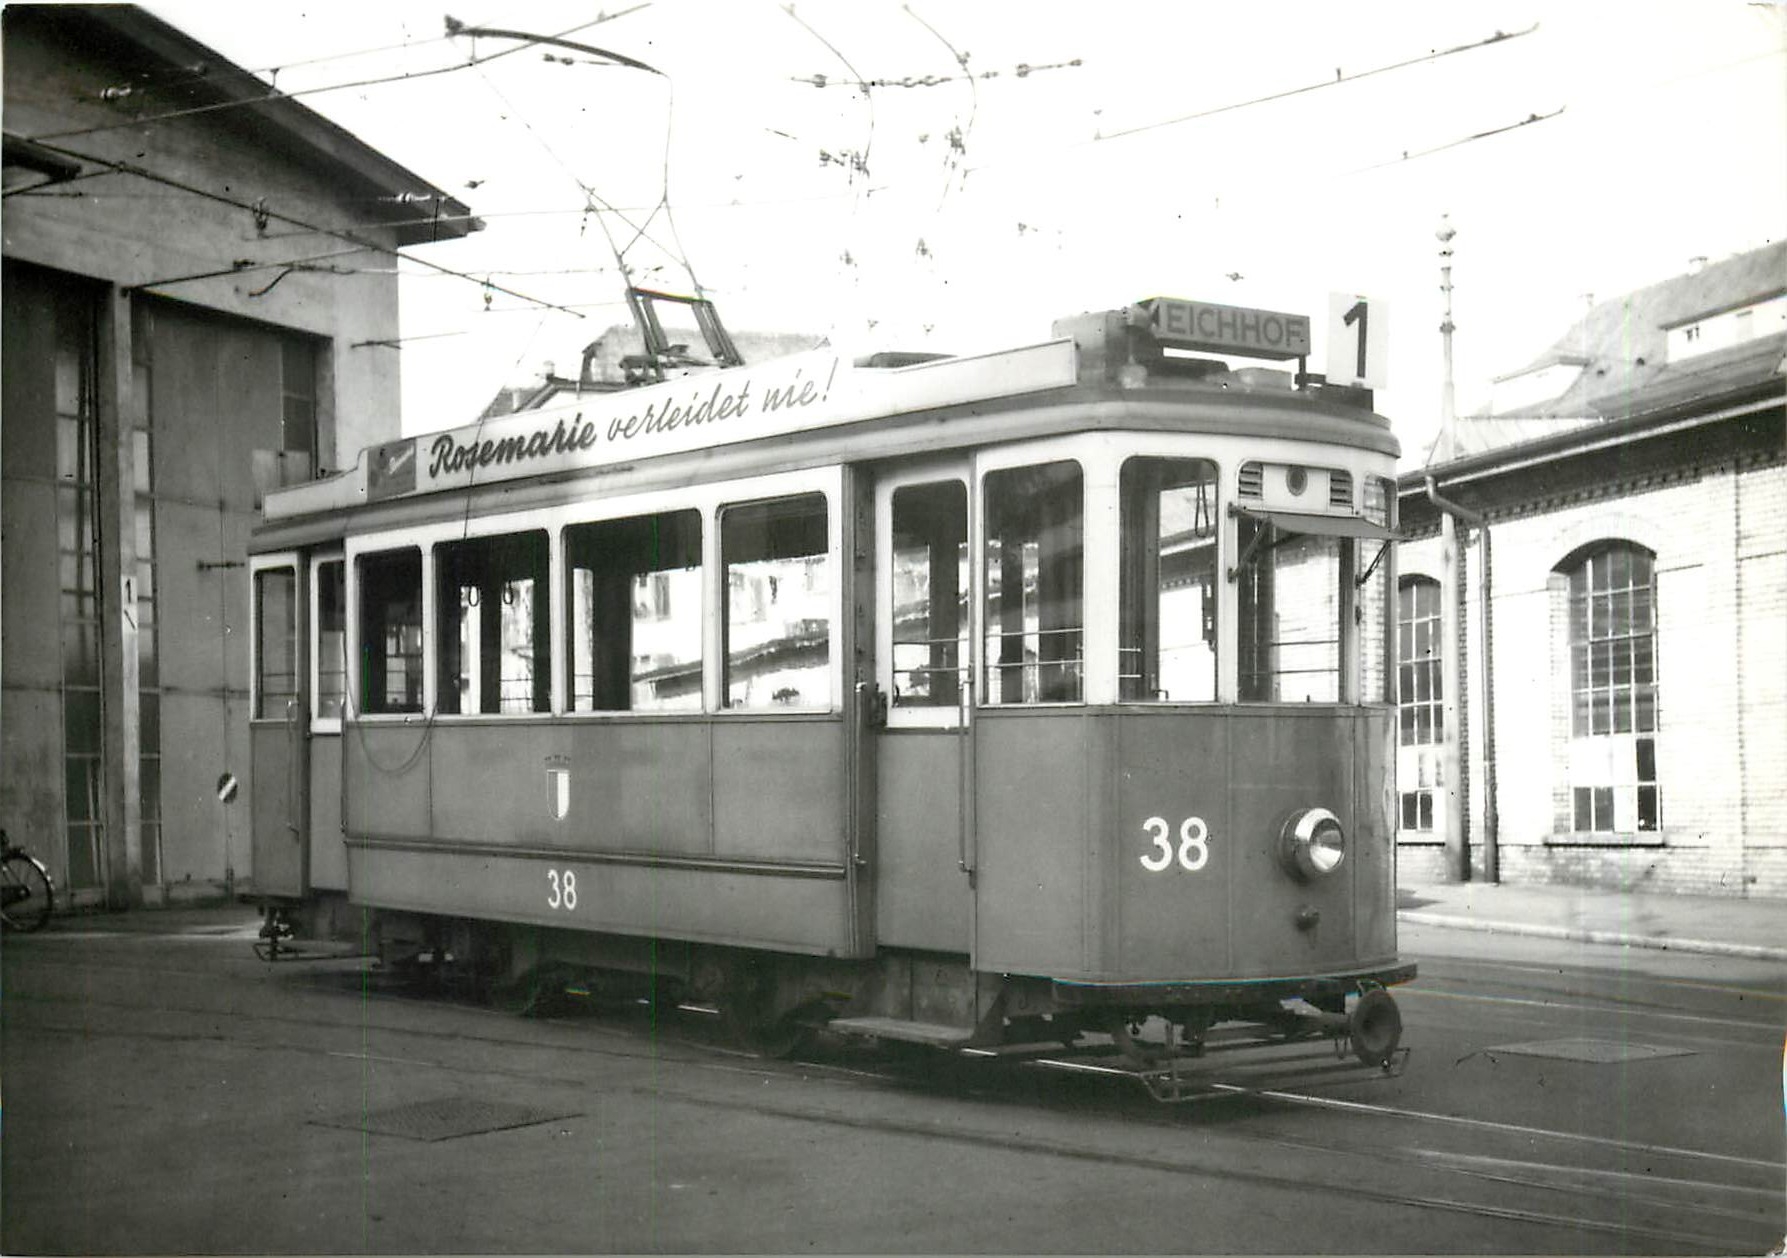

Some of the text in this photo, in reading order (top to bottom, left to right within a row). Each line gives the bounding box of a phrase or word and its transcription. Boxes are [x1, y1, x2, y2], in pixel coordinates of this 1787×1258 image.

[1166, 302, 1305, 347] EICHHOF
[1343, 301, 1368, 379] 1
[429, 356, 839, 479] Rosemarie verleidet nie!
[1139, 816, 1209, 871] 38
[547, 869, 577, 910] 38
